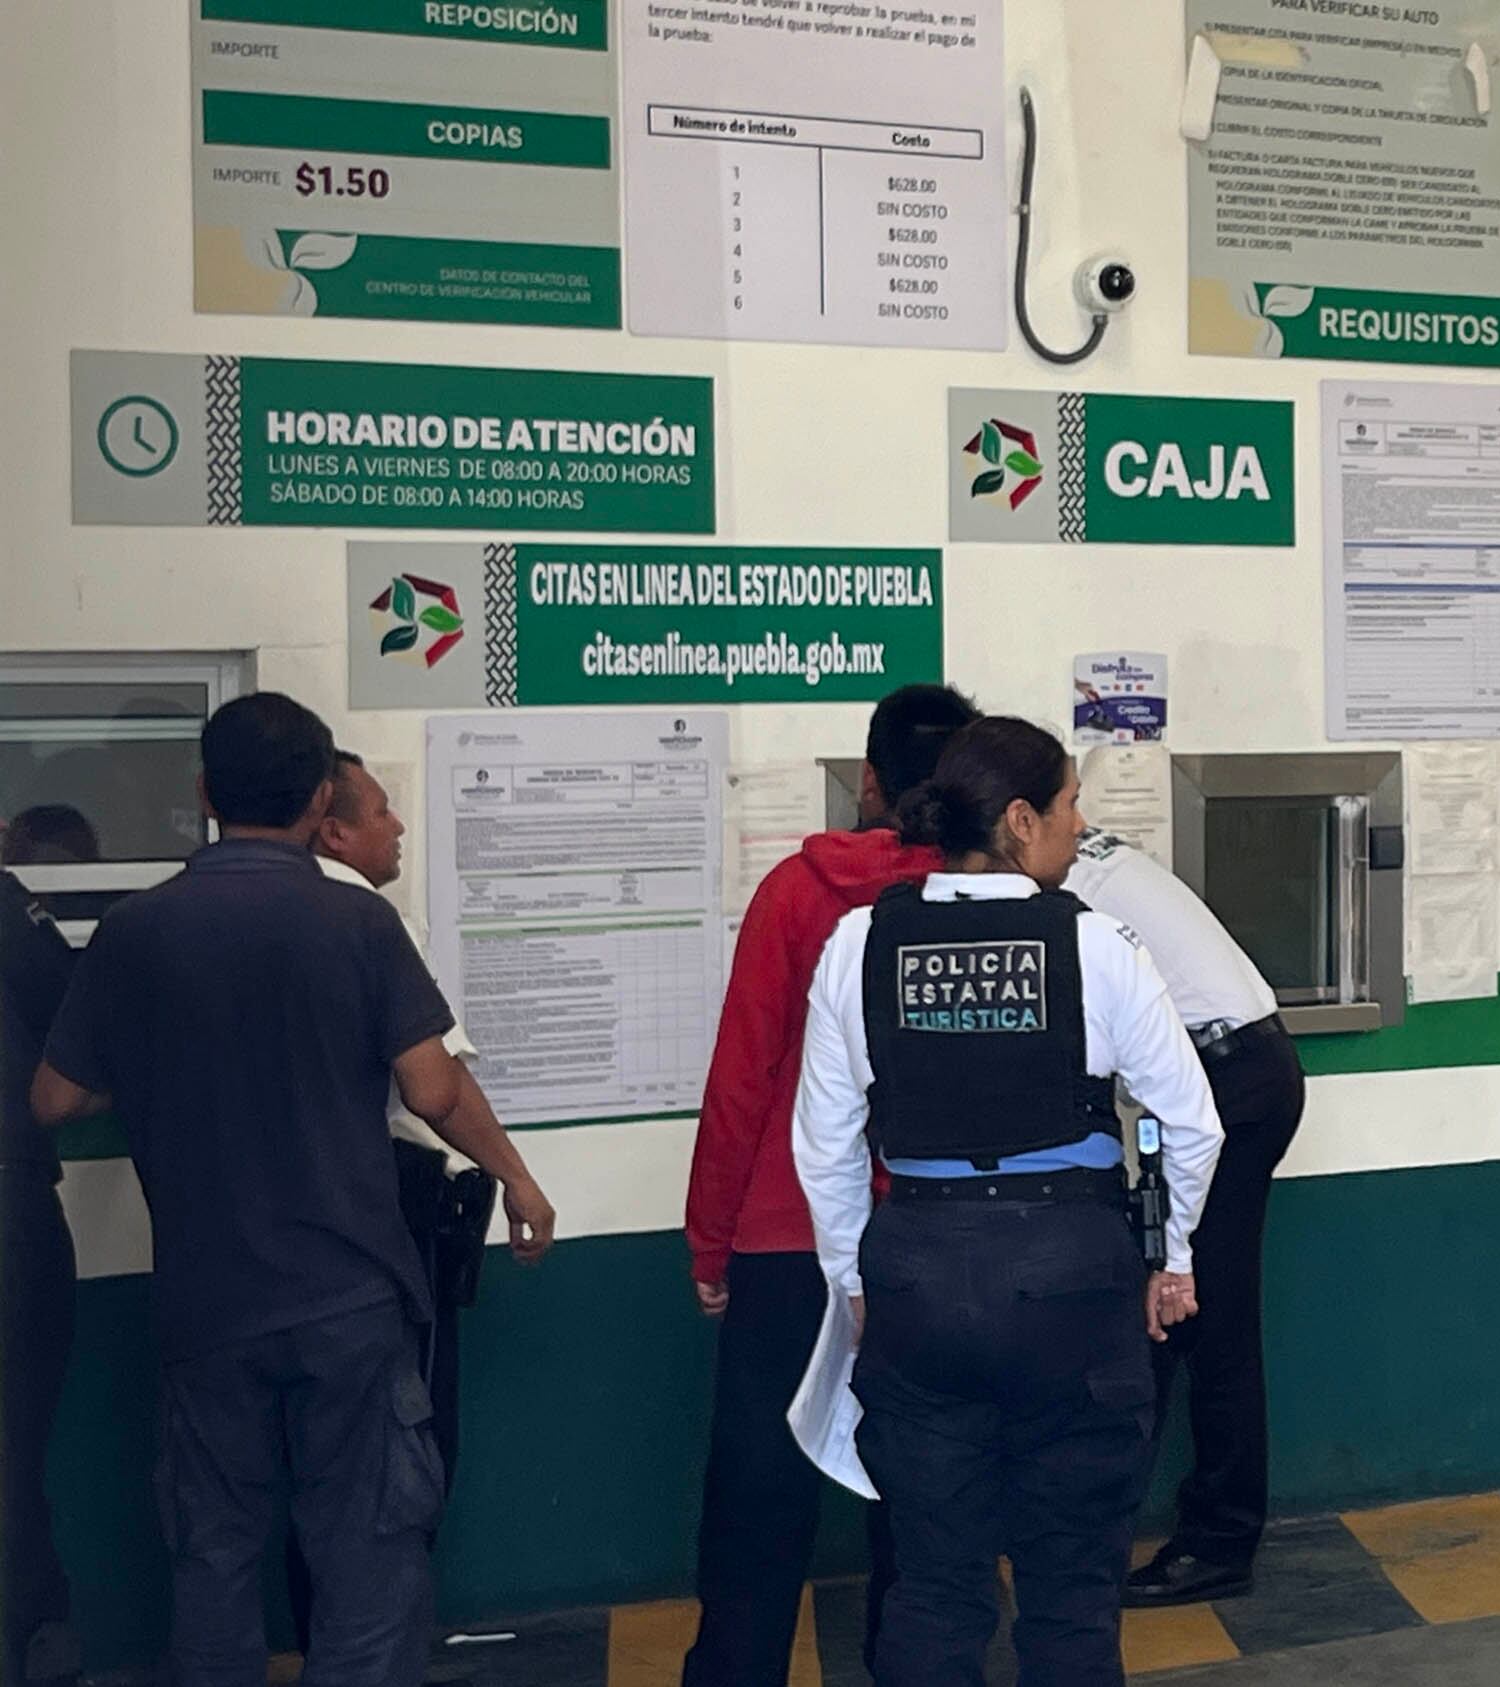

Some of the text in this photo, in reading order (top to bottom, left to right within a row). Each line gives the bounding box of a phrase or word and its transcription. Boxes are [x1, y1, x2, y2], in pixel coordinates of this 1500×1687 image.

[425, 2, 578, 35] REPOSICIÓN
[1382, 7, 1400, 21] SU
[1404, 10, 1439, 26] AUTO
[211, 42, 280, 60] IMPORTE
[428, 121, 522, 148] COPIAS
[673, 115, 930, 149] Número de intento Costo
[213, 162, 389, 197] IMPORTE $1.50
[733, 167, 740, 180] 1
[888, 176, 937, 193] $628.00
[733, 192, 741, 206] 2
[877, 202, 948, 219] SIN COSTO
[733, 218, 741, 232] 3
[888, 227, 938, 244] $628.00
[733, 244, 742, 257] 4
[877, 253, 948, 269] SIN COSTO
[733, 270, 742, 283] 5
[889, 278, 938, 294] $628.00
[733, 296, 743, 309] 6
[878, 303, 948, 320] SIN COSTO
[1319, 308, 1499, 346] REQUISITOS
[267, 410, 696, 457] HORARIO DE ATENCIÓN
[269, 454, 691, 485] LUNES A VIERNES DE 08:00 A 20:00 HORAS
[1104, 440, 1271, 500] CAJA
[271, 480, 585, 510] SÁBADO DE 08:00 A 14:00 HORAS
[531, 562, 934, 607] CITAS EN LINEA DEL ESTADO DE PUEBLA
[583, 631, 886, 686] citasenlinea.puebla.gob.mx
[904, 946, 1038, 977] POLICÍA
[904, 979, 1039, 1005] ESTATAL
[906, 1002, 1039, 1030] TURÍSTICA
